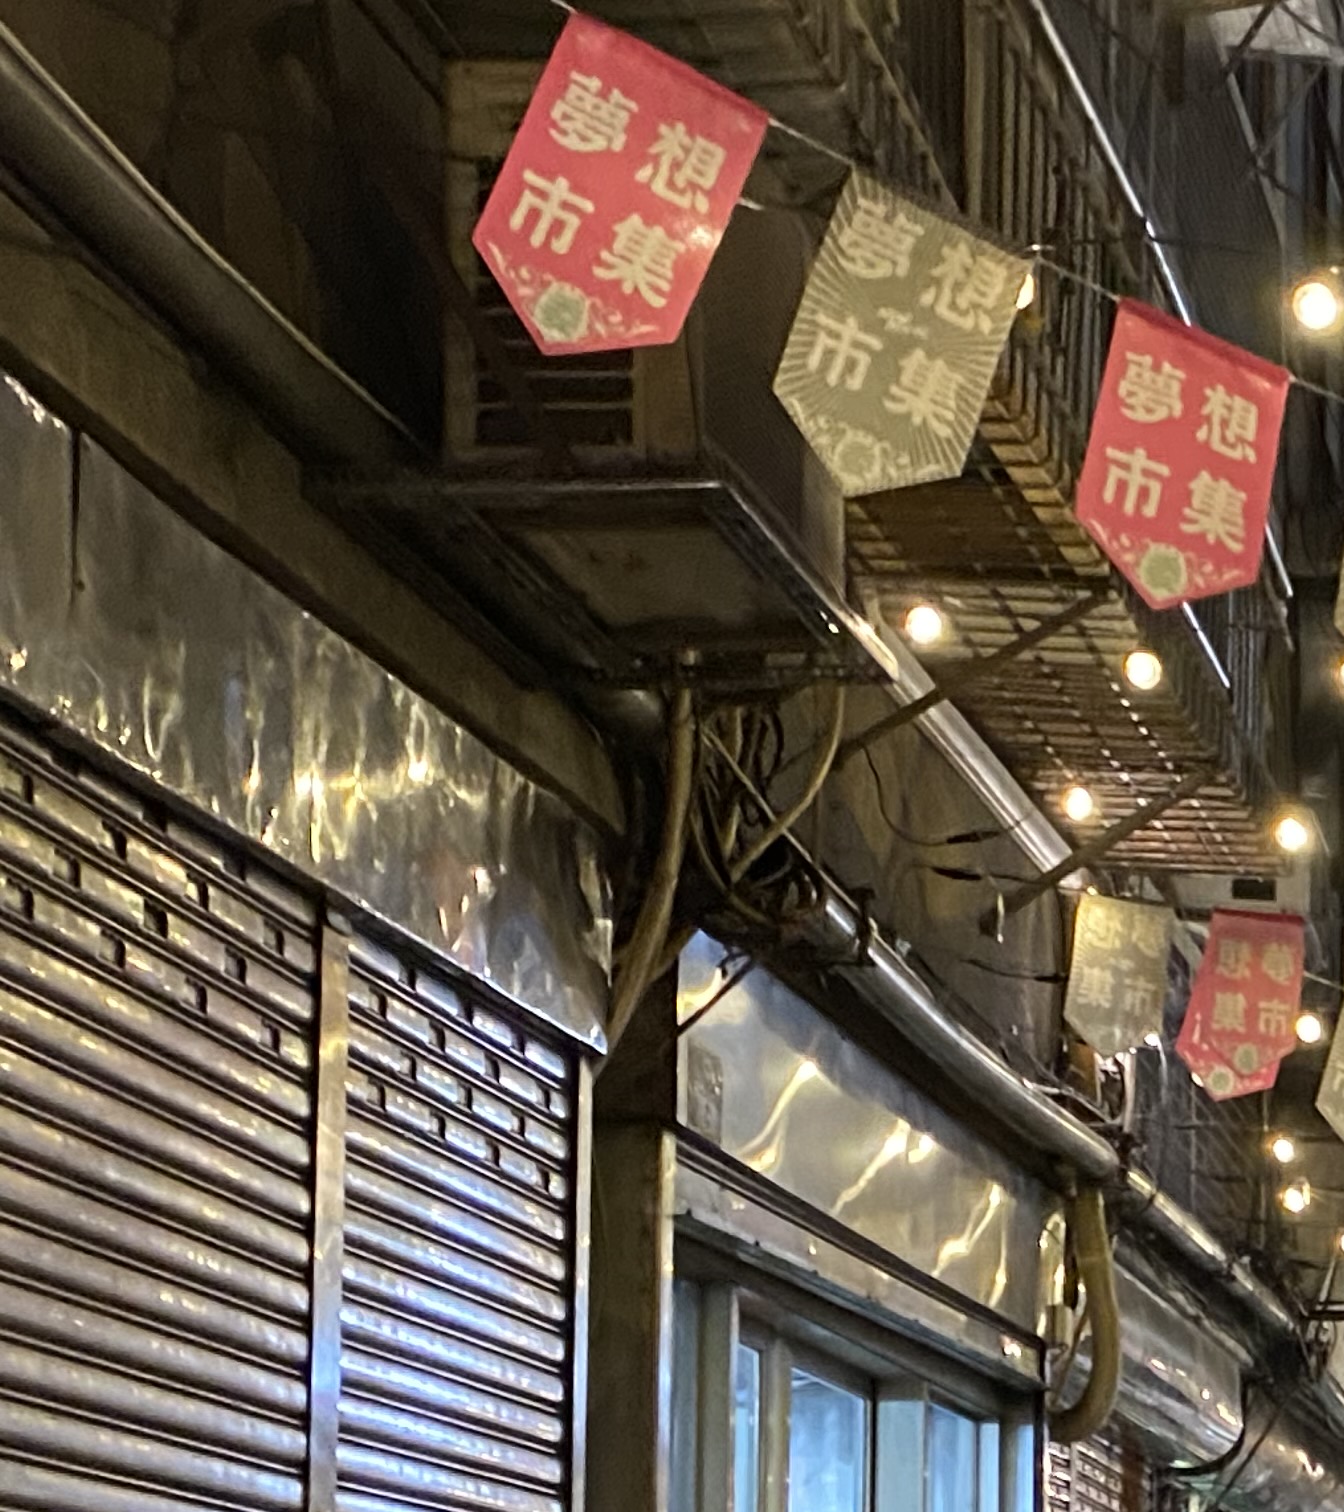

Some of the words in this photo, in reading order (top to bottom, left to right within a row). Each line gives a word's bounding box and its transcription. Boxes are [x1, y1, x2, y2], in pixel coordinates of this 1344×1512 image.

[548, 71, 727, 213] 夢想
[508, 170, 687, 309] 市集
[837, 199, 1007, 336] 夢想
[808, 311, 964, 438] 市集
[1116, 350, 1259, 466] 夢想
[1102, 444, 1248, 555] 市集
